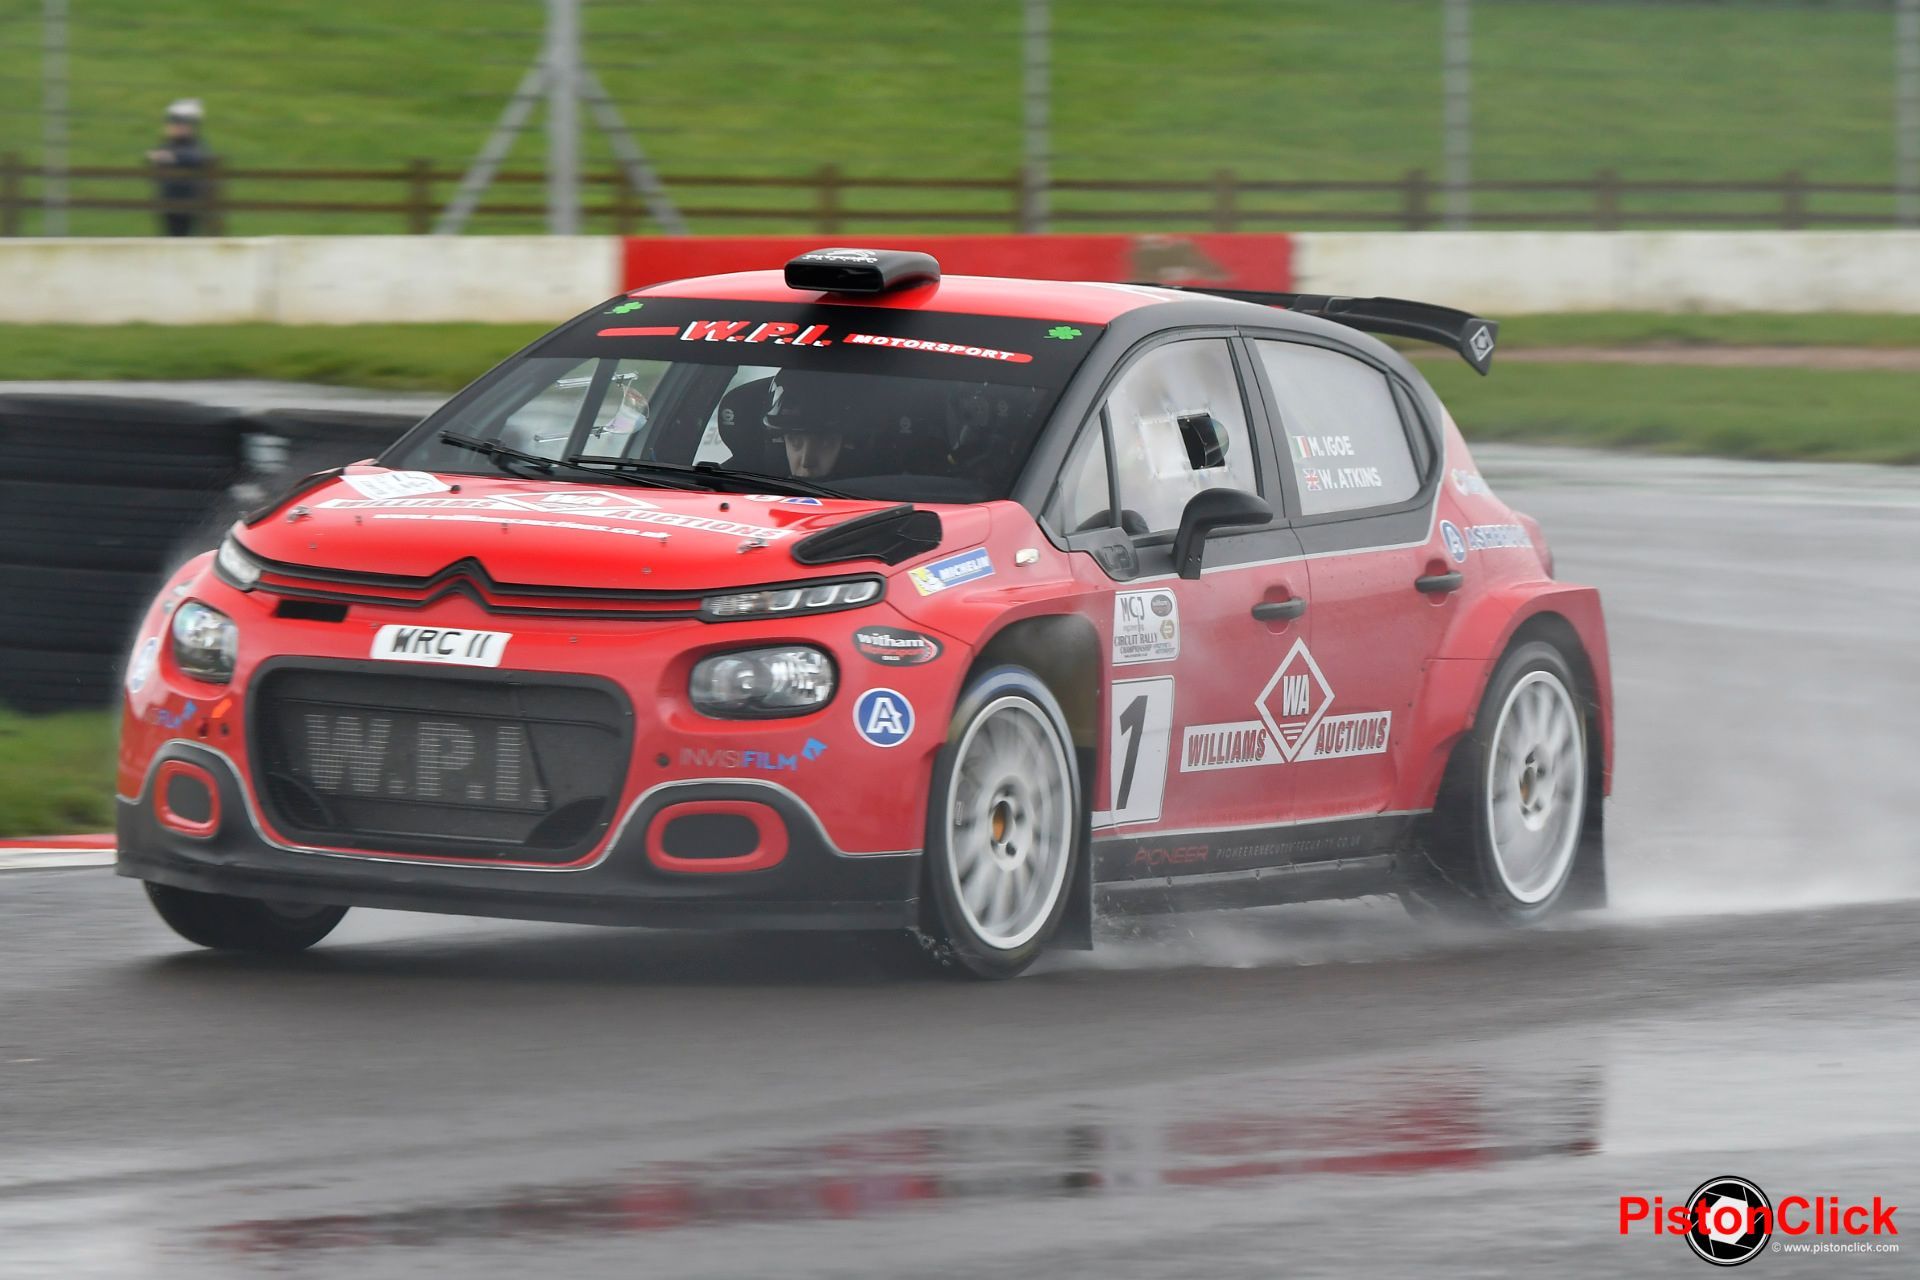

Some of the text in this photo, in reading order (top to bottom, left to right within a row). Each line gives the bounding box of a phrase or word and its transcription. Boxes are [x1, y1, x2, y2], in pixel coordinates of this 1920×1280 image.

[680, 320, 1014, 361] W.P.I. MOTORSPORT
[1337, 466, 1382, 488] ATKINS
[607, 509, 782, 539] AUCTIONS
[938, 556, 991, 581] MICHELIN
[391, 627, 461, 655] WRC
[856, 632, 925, 648] witham
[1114, 631, 1158, 647] CIRCUIT RALLY
[1282, 673, 1310, 717] WA
[866, 696, 906, 735] A
[1116, 694, 1149, 811] 1
[1187, 716, 1388, 768] WILLIAMS AUCTIONS
[304, 714, 549, 804] W.P.I.
[679, 747, 798, 771] INVISIFILM
[1134, 845, 1209, 865] PIONEER
